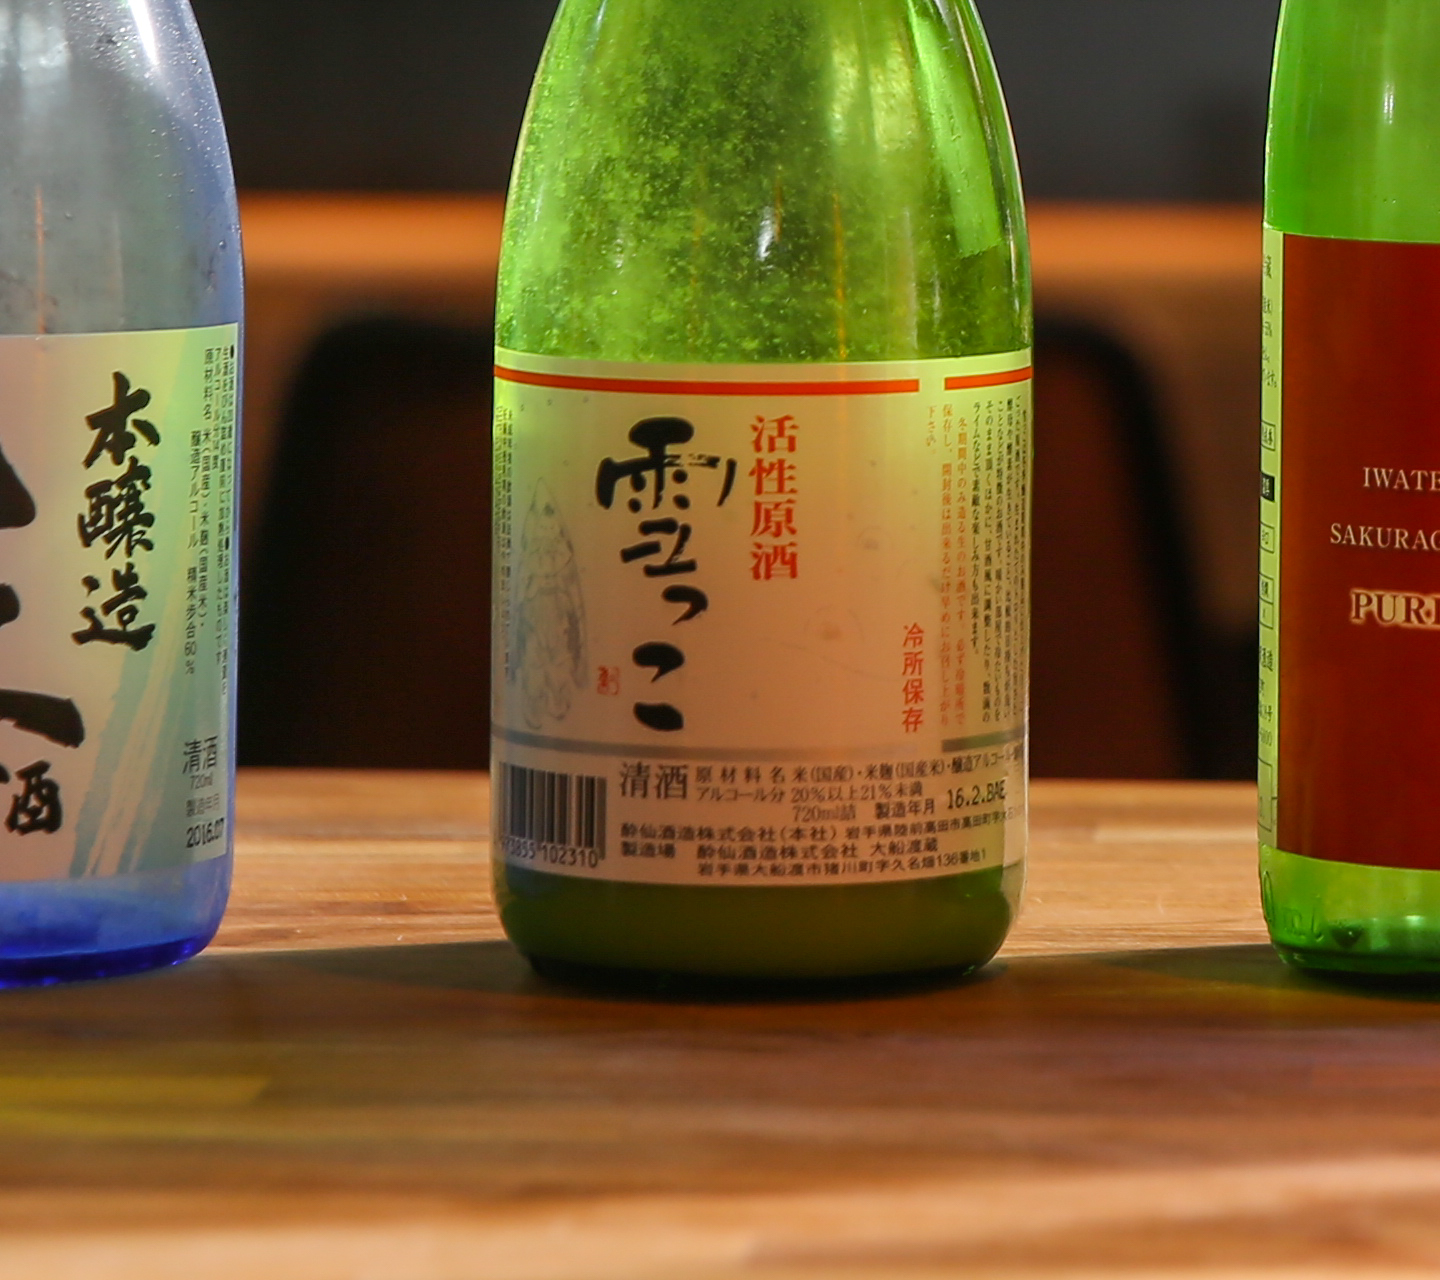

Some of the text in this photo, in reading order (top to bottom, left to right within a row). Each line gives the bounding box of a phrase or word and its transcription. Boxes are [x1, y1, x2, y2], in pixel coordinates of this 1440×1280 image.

[71, 371, 161, 652] 本醸造
[748, 414, 800, 581] 活性原酒
[900, 621, 925, 734] 冷所保存
[619, 760, 689, 800] 清酒
[695, 765, 786, 784] 原材料名
[874, 797, 936, 821] 製造年月
[540, 843, 599, 869] 102310
